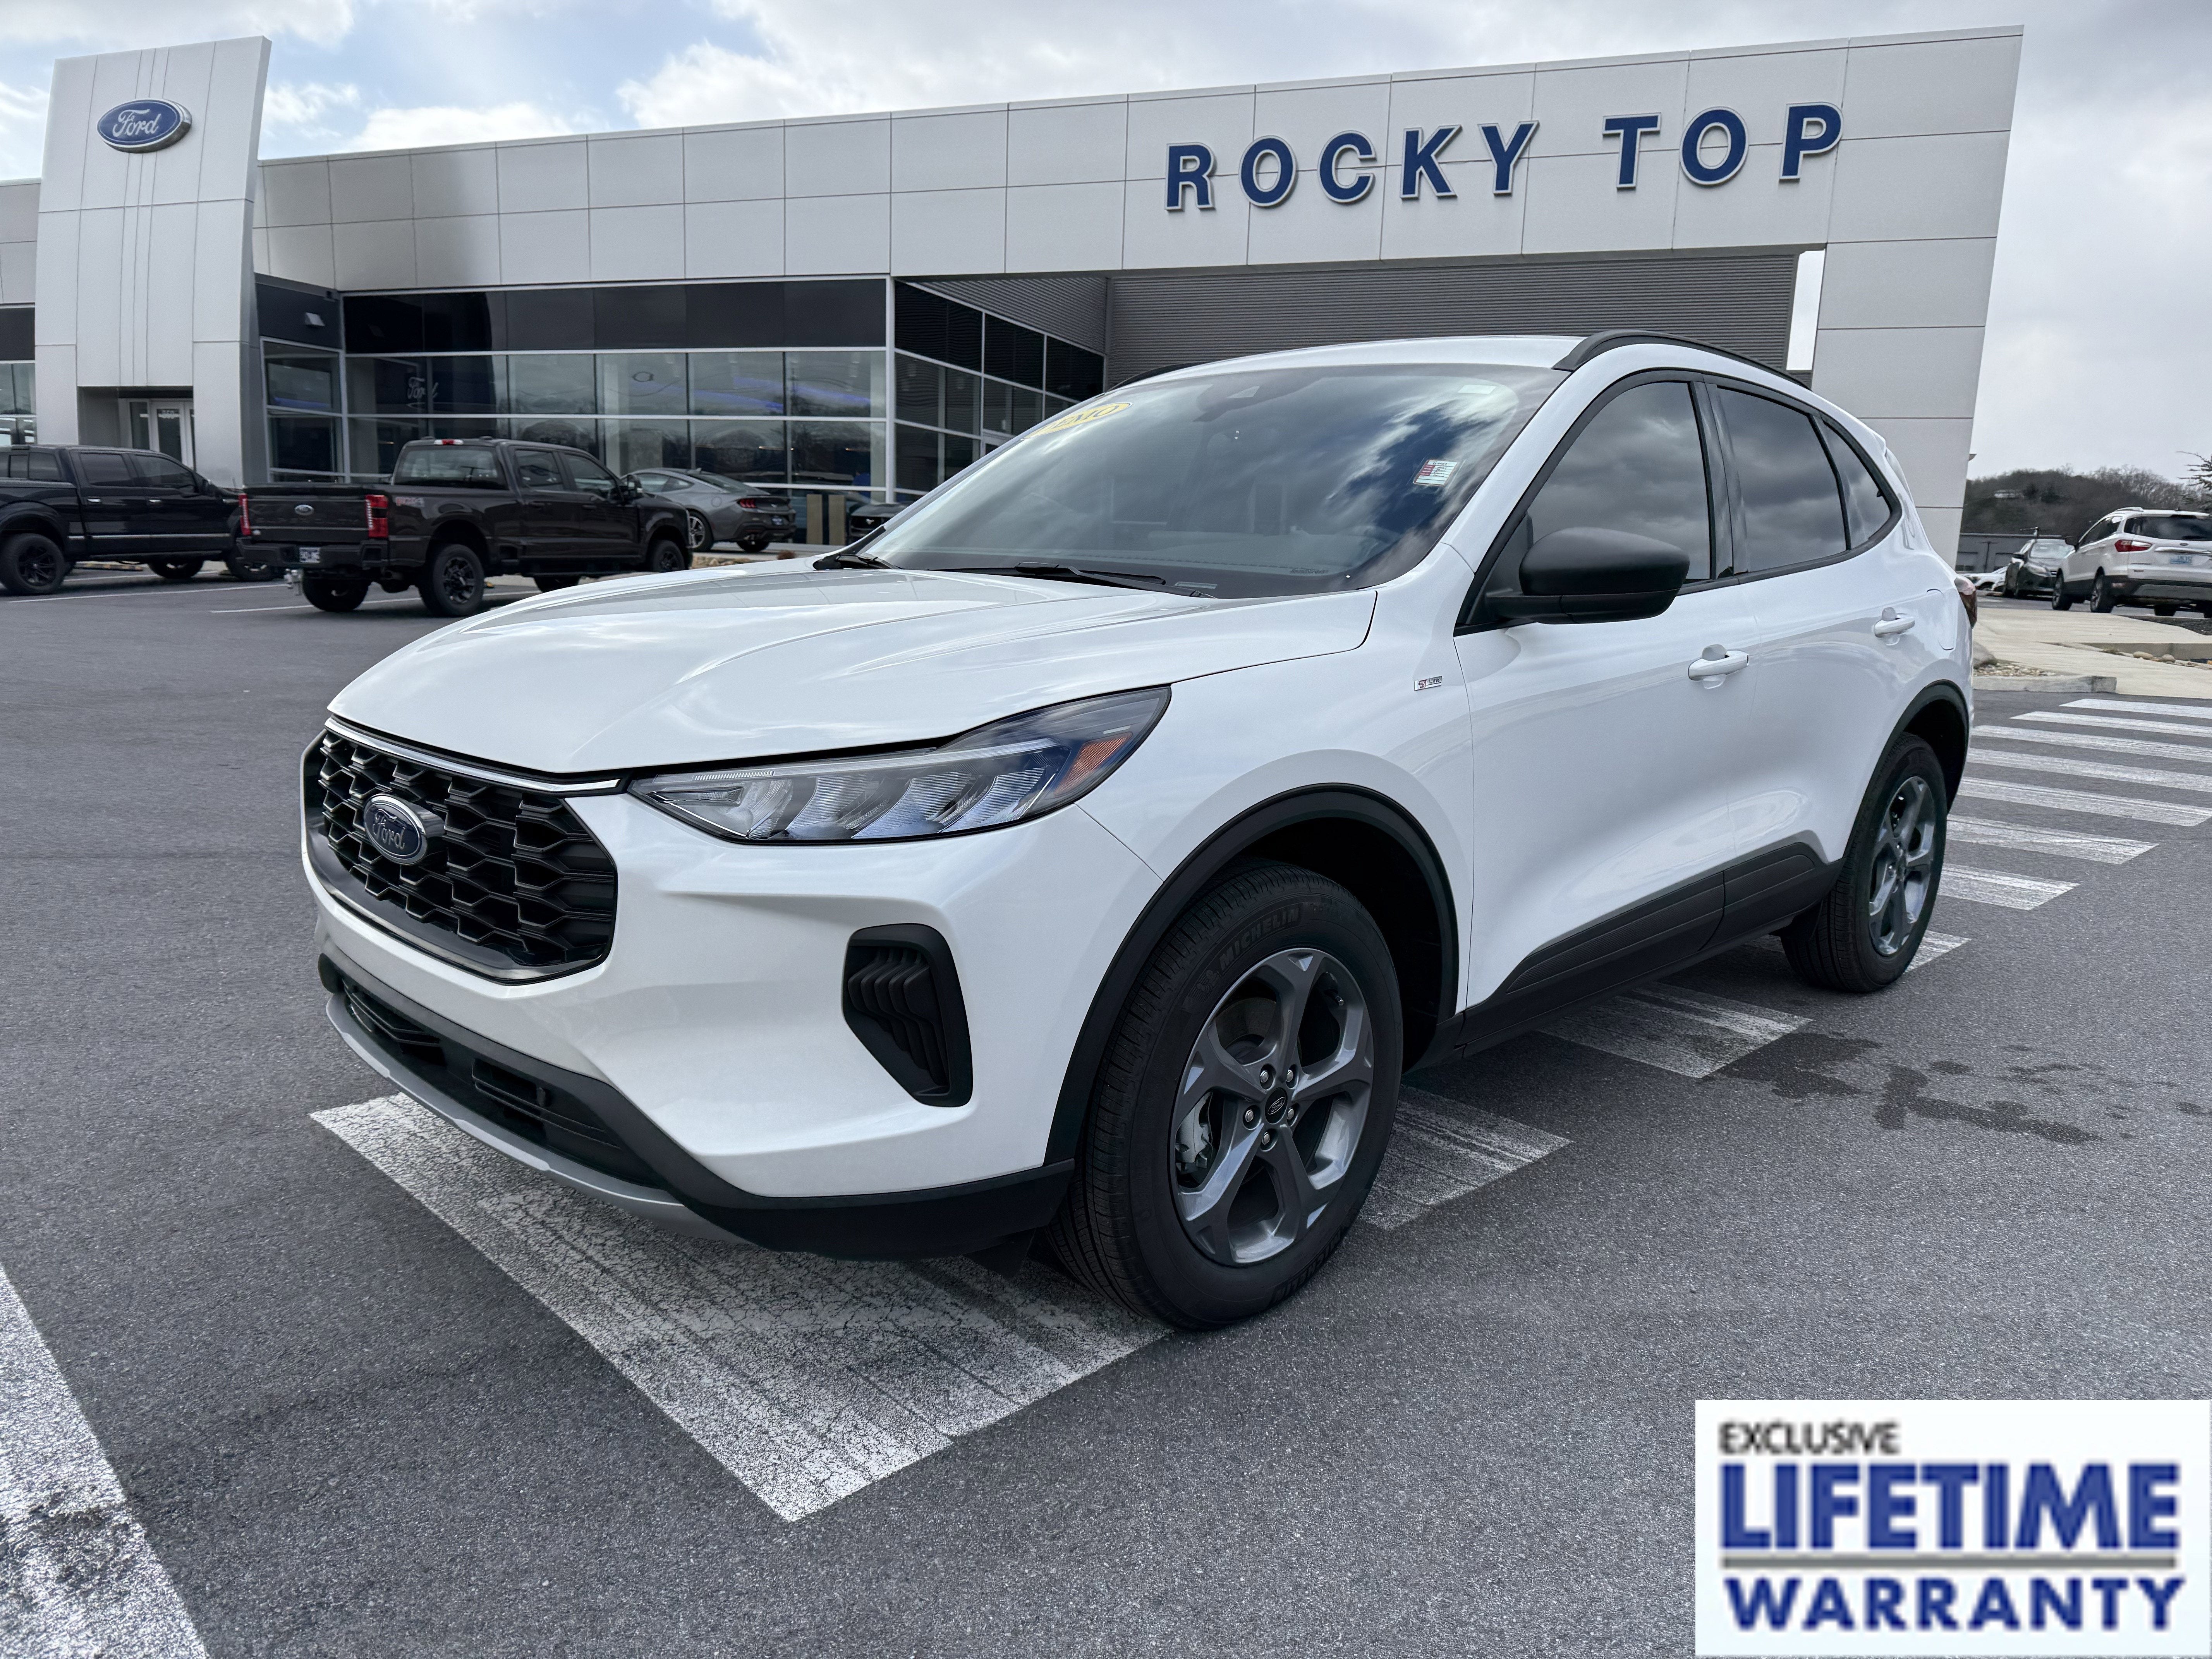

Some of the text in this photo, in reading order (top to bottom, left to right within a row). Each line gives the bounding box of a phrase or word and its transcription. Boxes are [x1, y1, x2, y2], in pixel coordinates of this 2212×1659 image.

[112, 109, 161, 137] Ford
[1166, 103, 1843, 210] ROCKY TOP
[373, 809, 405, 850] Ford
[1219, 908, 1300, 969] MICHELIN
[1271, 1101, 1283, 1113] Ford
